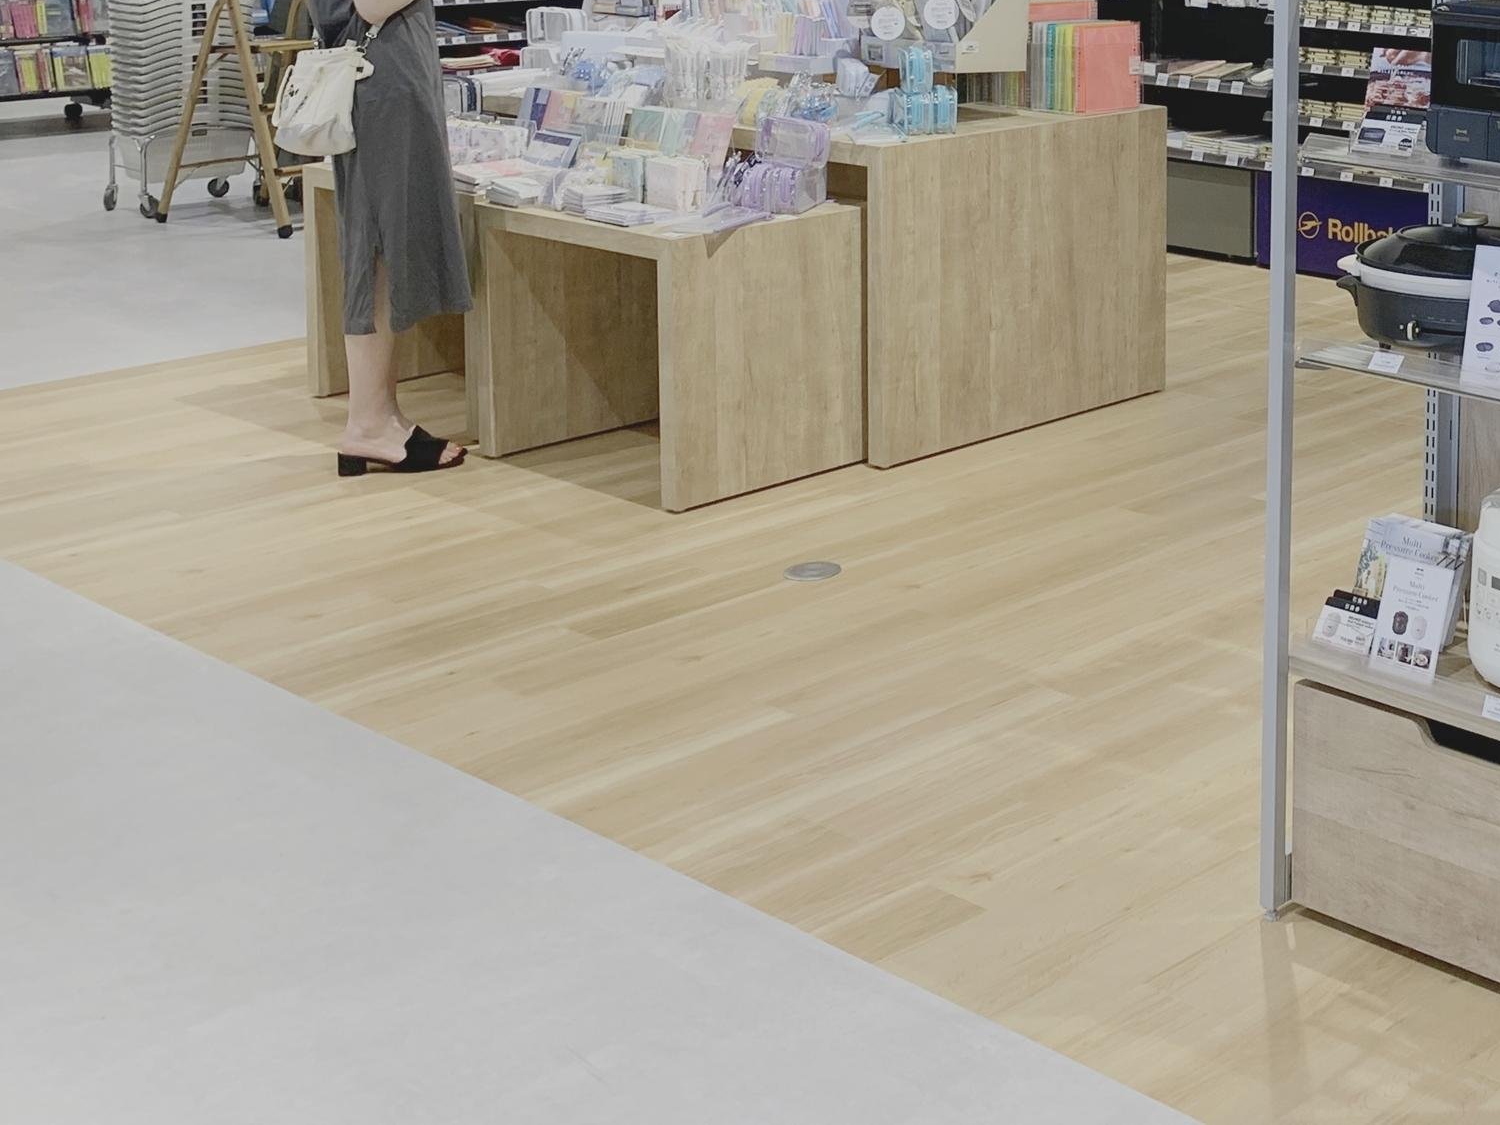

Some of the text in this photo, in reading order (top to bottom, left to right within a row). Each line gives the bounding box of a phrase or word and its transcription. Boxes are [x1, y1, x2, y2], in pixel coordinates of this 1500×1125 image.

[1380, 540, 1440, 562] Pressure Cooker
[1401, 536, 1423, 549] Multi
